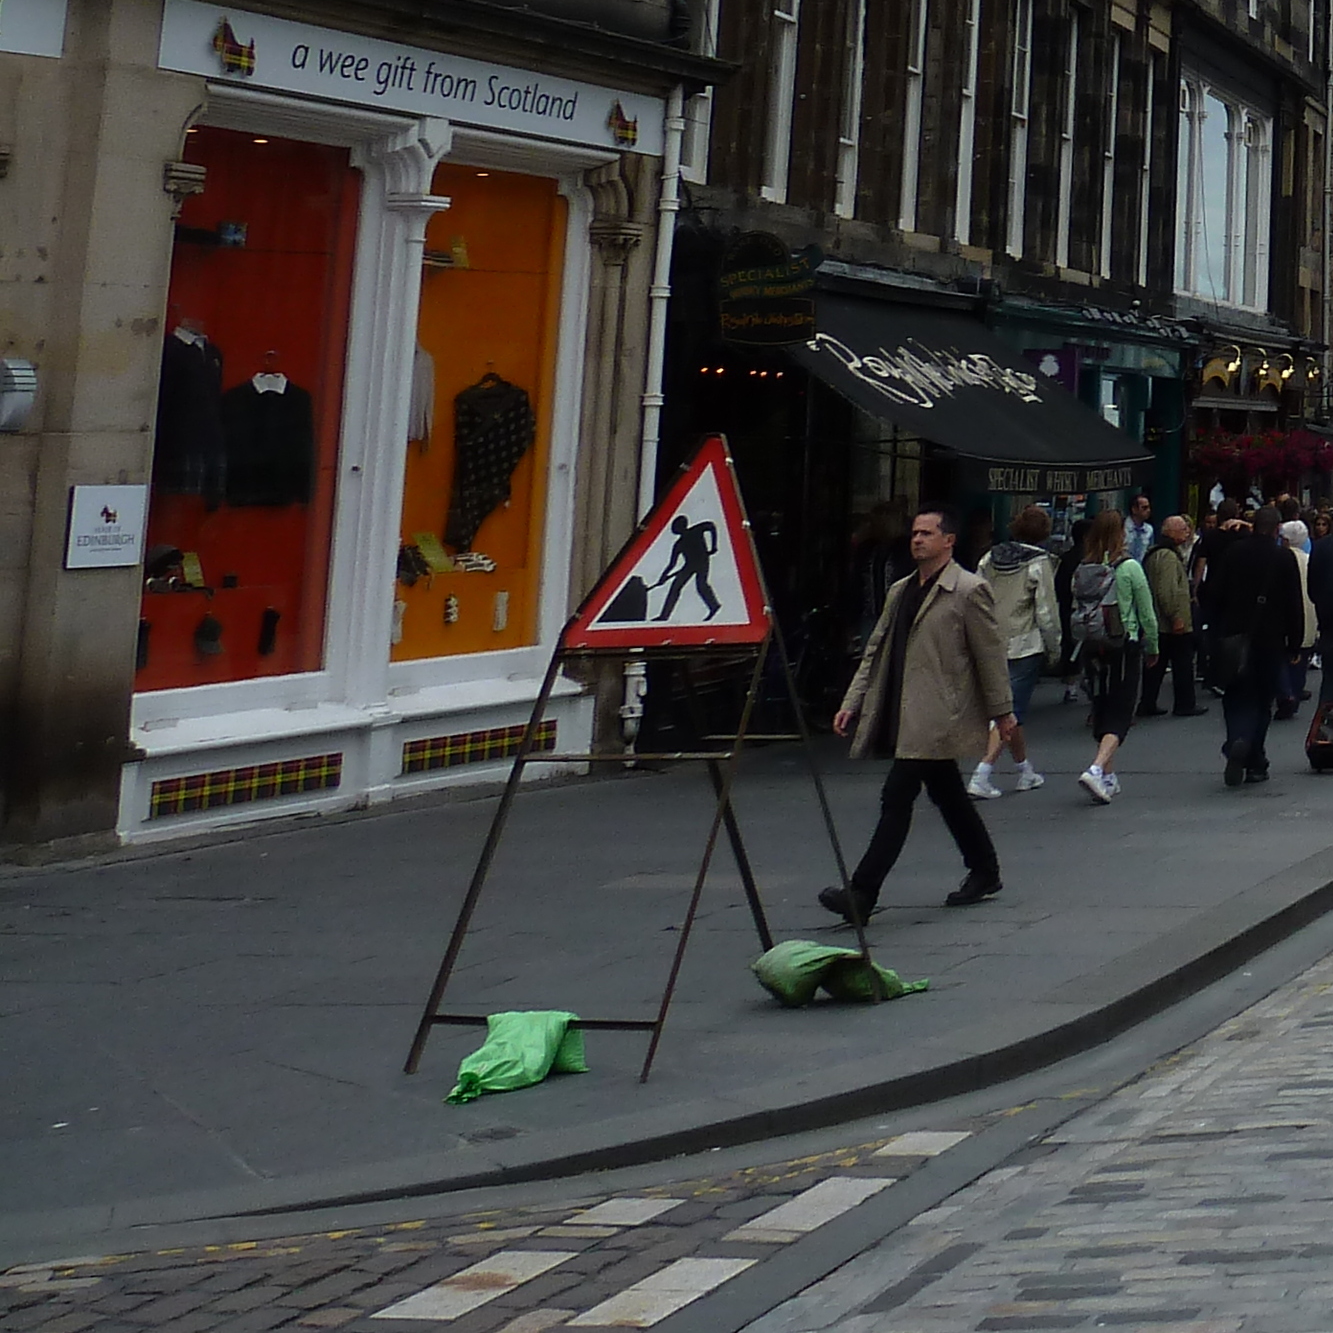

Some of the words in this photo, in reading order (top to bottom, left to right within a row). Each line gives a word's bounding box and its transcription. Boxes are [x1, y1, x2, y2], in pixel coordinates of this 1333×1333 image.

[291, 43, 310, 69] a
[319, 47, 370, 82] wee
[373, 55, 418, 96] gift
[423, 61, 477, 103] from
[484, 74, 579, 121] Scotland
[720, 257, 811, 287] SPECIALIST
